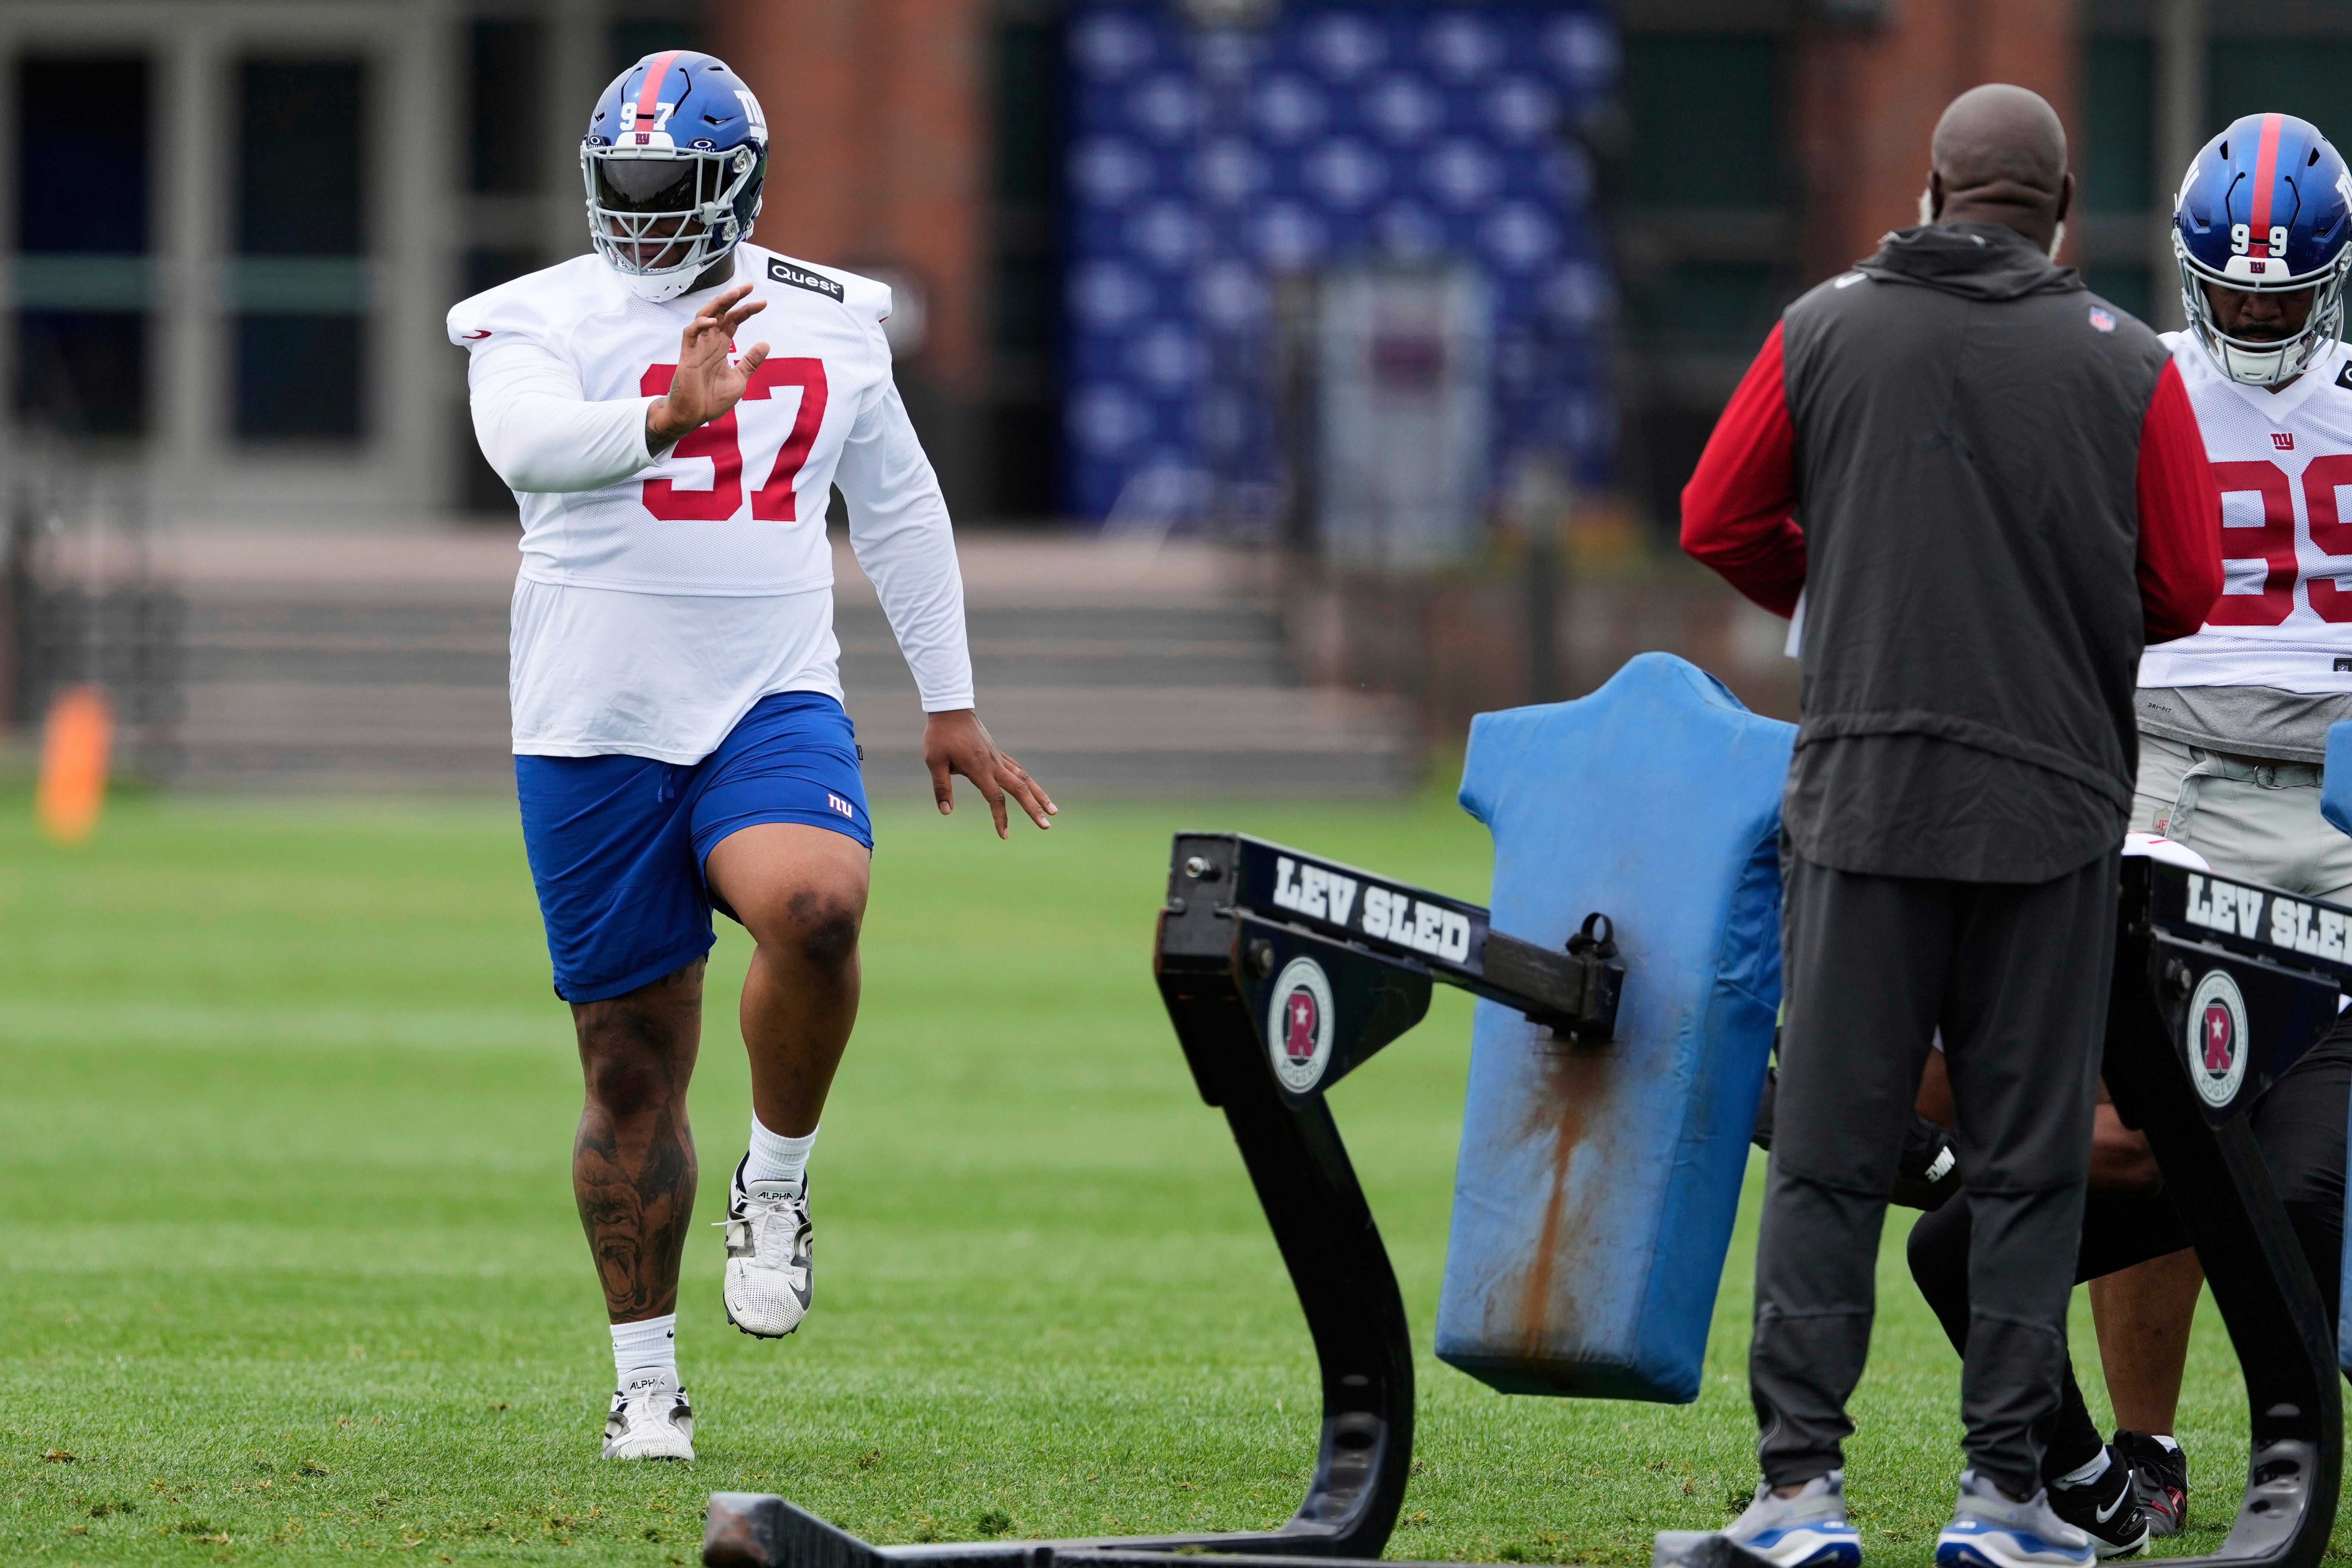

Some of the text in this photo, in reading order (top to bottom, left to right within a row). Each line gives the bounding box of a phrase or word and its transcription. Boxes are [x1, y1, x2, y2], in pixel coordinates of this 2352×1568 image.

[620, 102, 675, 131] 97
[2231, 224, 2287, 256] 99
[772, 265, 839, 294] Quest
[640, 357, 828, 521] 97
[2148, 703, 2172, 713] DRI-FIT
[1273, 856, 1471, 962] LEV SLED
[2186, 873, 2263, 939] LEV
[1925, 1146, 1955, 1183] NIKE
[758, 1191, 793, 1200] ALPHA
